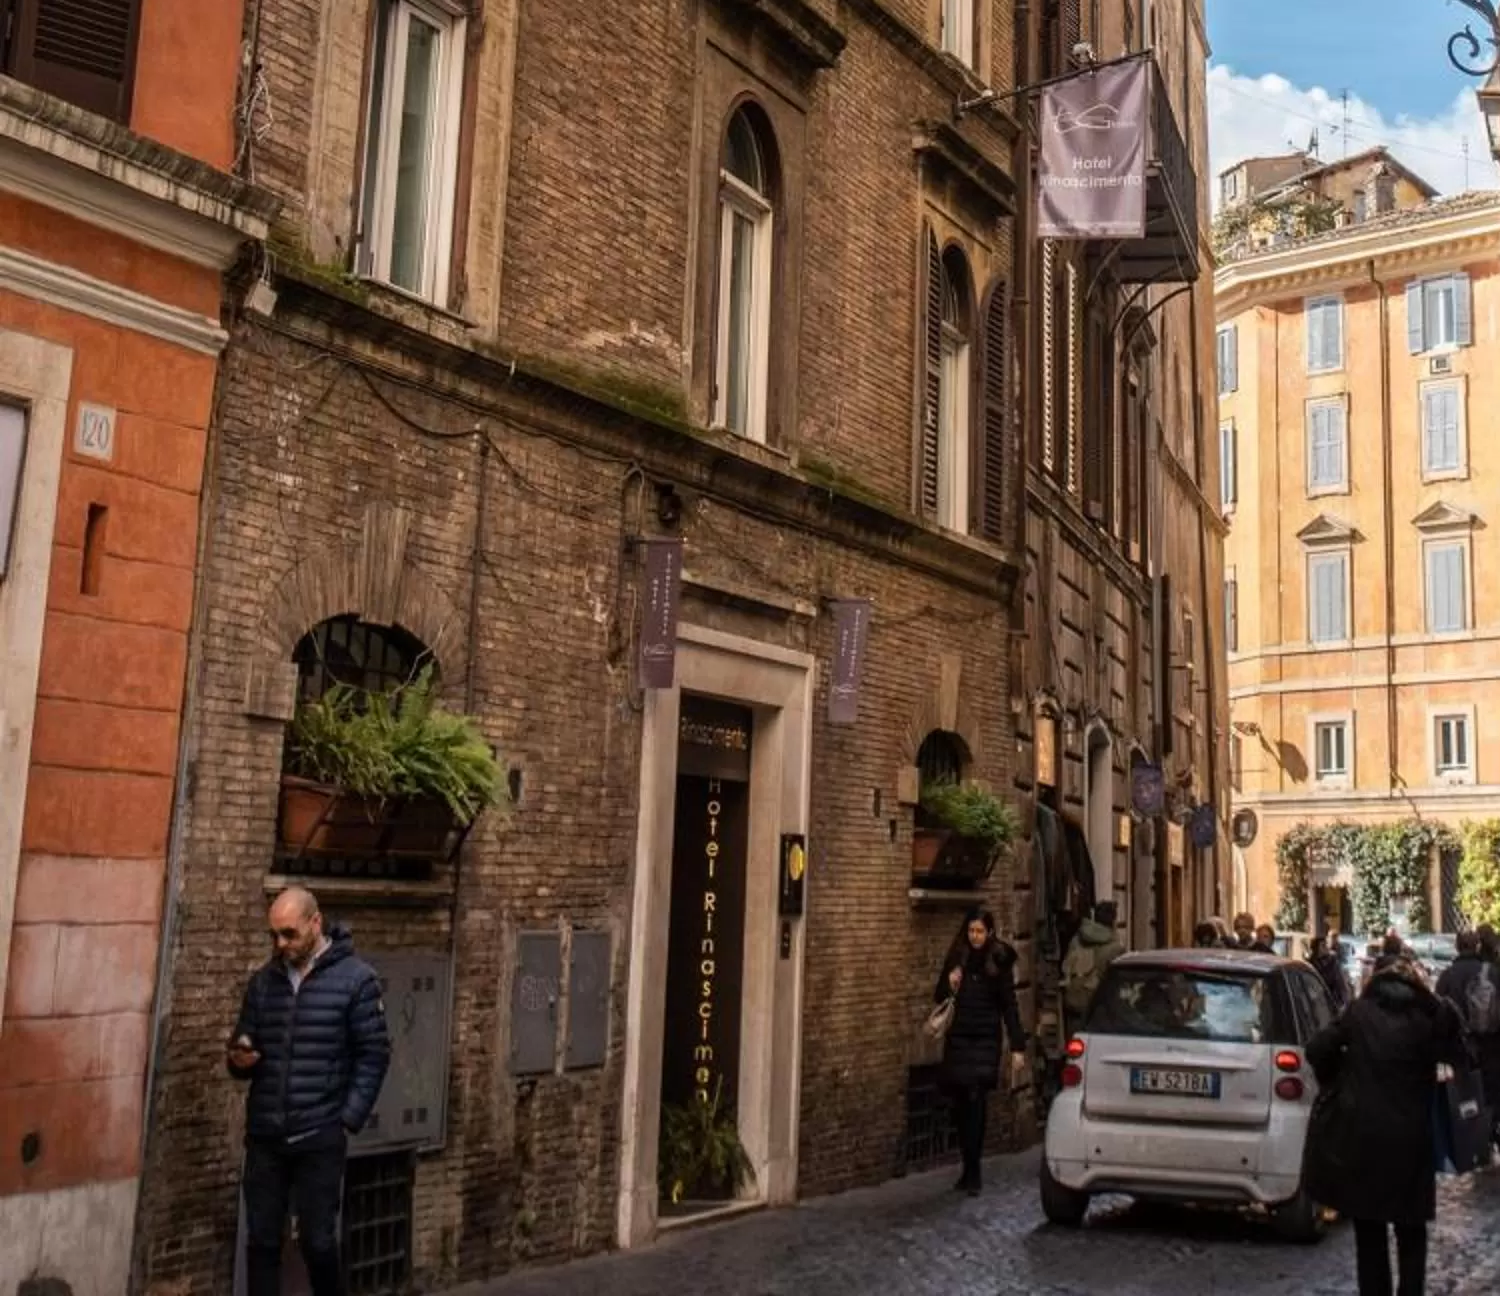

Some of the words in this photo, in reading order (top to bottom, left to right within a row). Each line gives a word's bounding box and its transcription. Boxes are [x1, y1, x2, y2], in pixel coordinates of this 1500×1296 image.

[1072, 155, 1111, 170] Hotel
[82, 410, 110, 451] 120
[706, 774, 721, 878] Hotel
[694, 891, 716, 1103] Rinascimen
